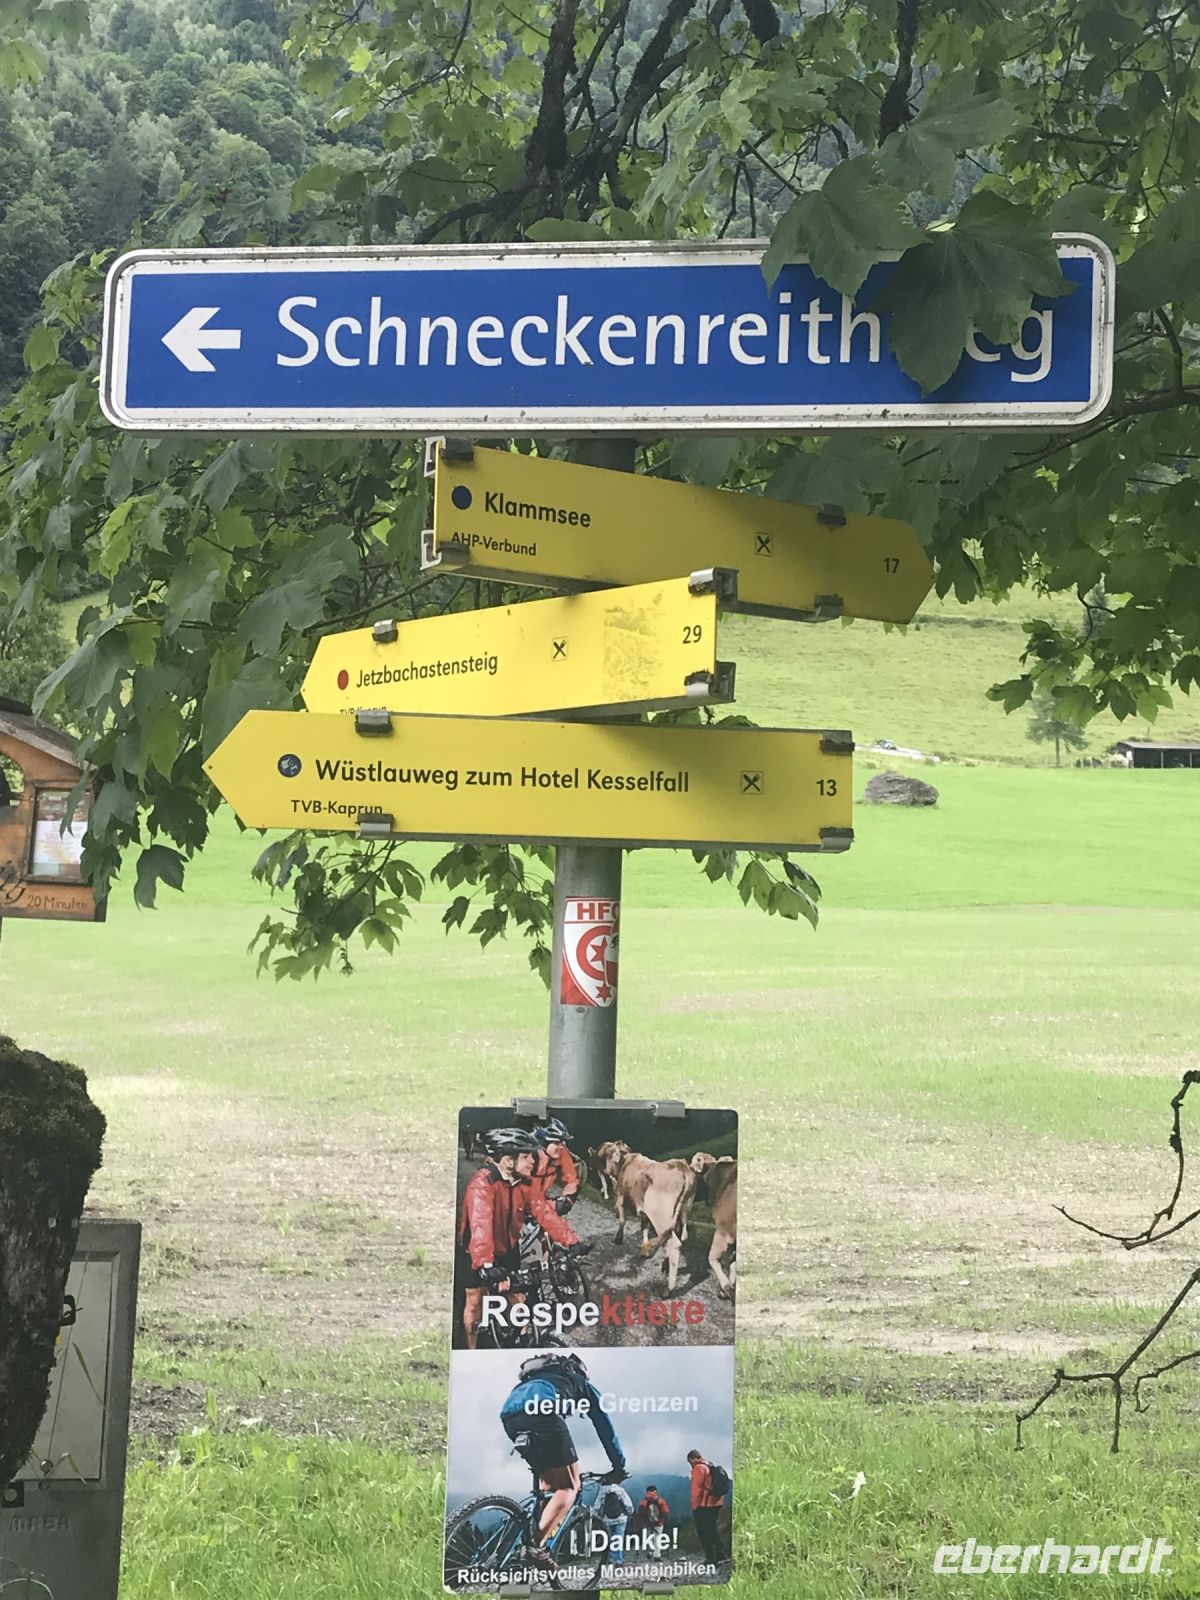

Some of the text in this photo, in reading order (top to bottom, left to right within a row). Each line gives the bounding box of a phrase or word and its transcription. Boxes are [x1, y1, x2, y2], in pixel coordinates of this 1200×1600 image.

[277, 292, 1053, 383] Schneckenreitheg
[485, 491, 591, 527] Klammsee
[451, 532, 537, 556] AHP-Verbund
[884, 557, 900, 574] 17
[682, 625, 702, 644] 29
[356, 651, 498, 688] Jetzbachastensteig
[316, 760, 689, 792] Wüstlauweg zum Hotel Kesselfall
[816, 779, 837, 796] 13
[291, 800, 383, 818] TVB-Kaprun
[481, 1293, 705, 1334] Respektiere
[524, 1392, 699, 1416] deine Grenzen
[591, 1528, 679, 1552] Danke!
[457, 1562, 716, 1584] Rücksichtsvolles Mountainbiken
